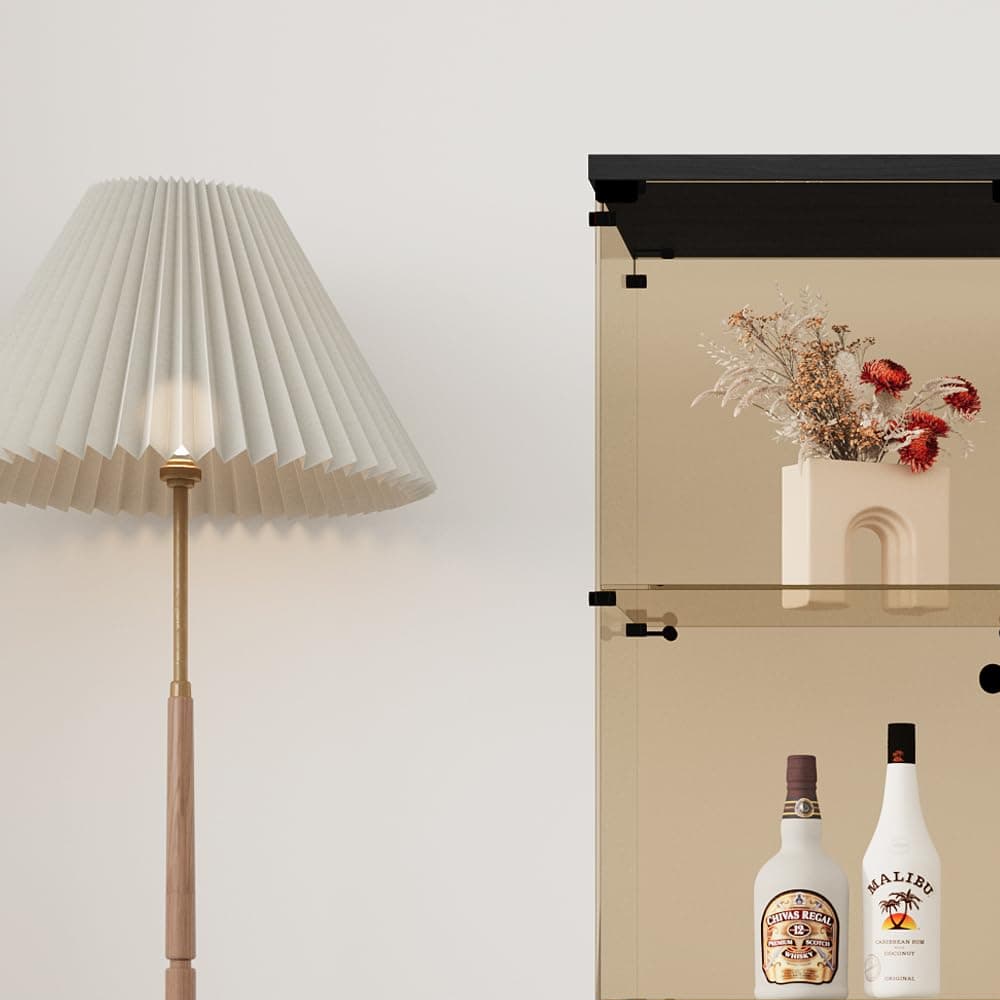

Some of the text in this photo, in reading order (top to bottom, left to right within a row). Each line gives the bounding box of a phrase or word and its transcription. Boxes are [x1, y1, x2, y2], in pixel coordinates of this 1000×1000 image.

[867, 871, 934, 897] MALIBU
[767, 910, 832, 926] CHIVAS REGAL
[793, 925, 805, 936] 12
[806, 939, 831, 947] SCOTCH
[784, 950, 815, 960] WHISKY
